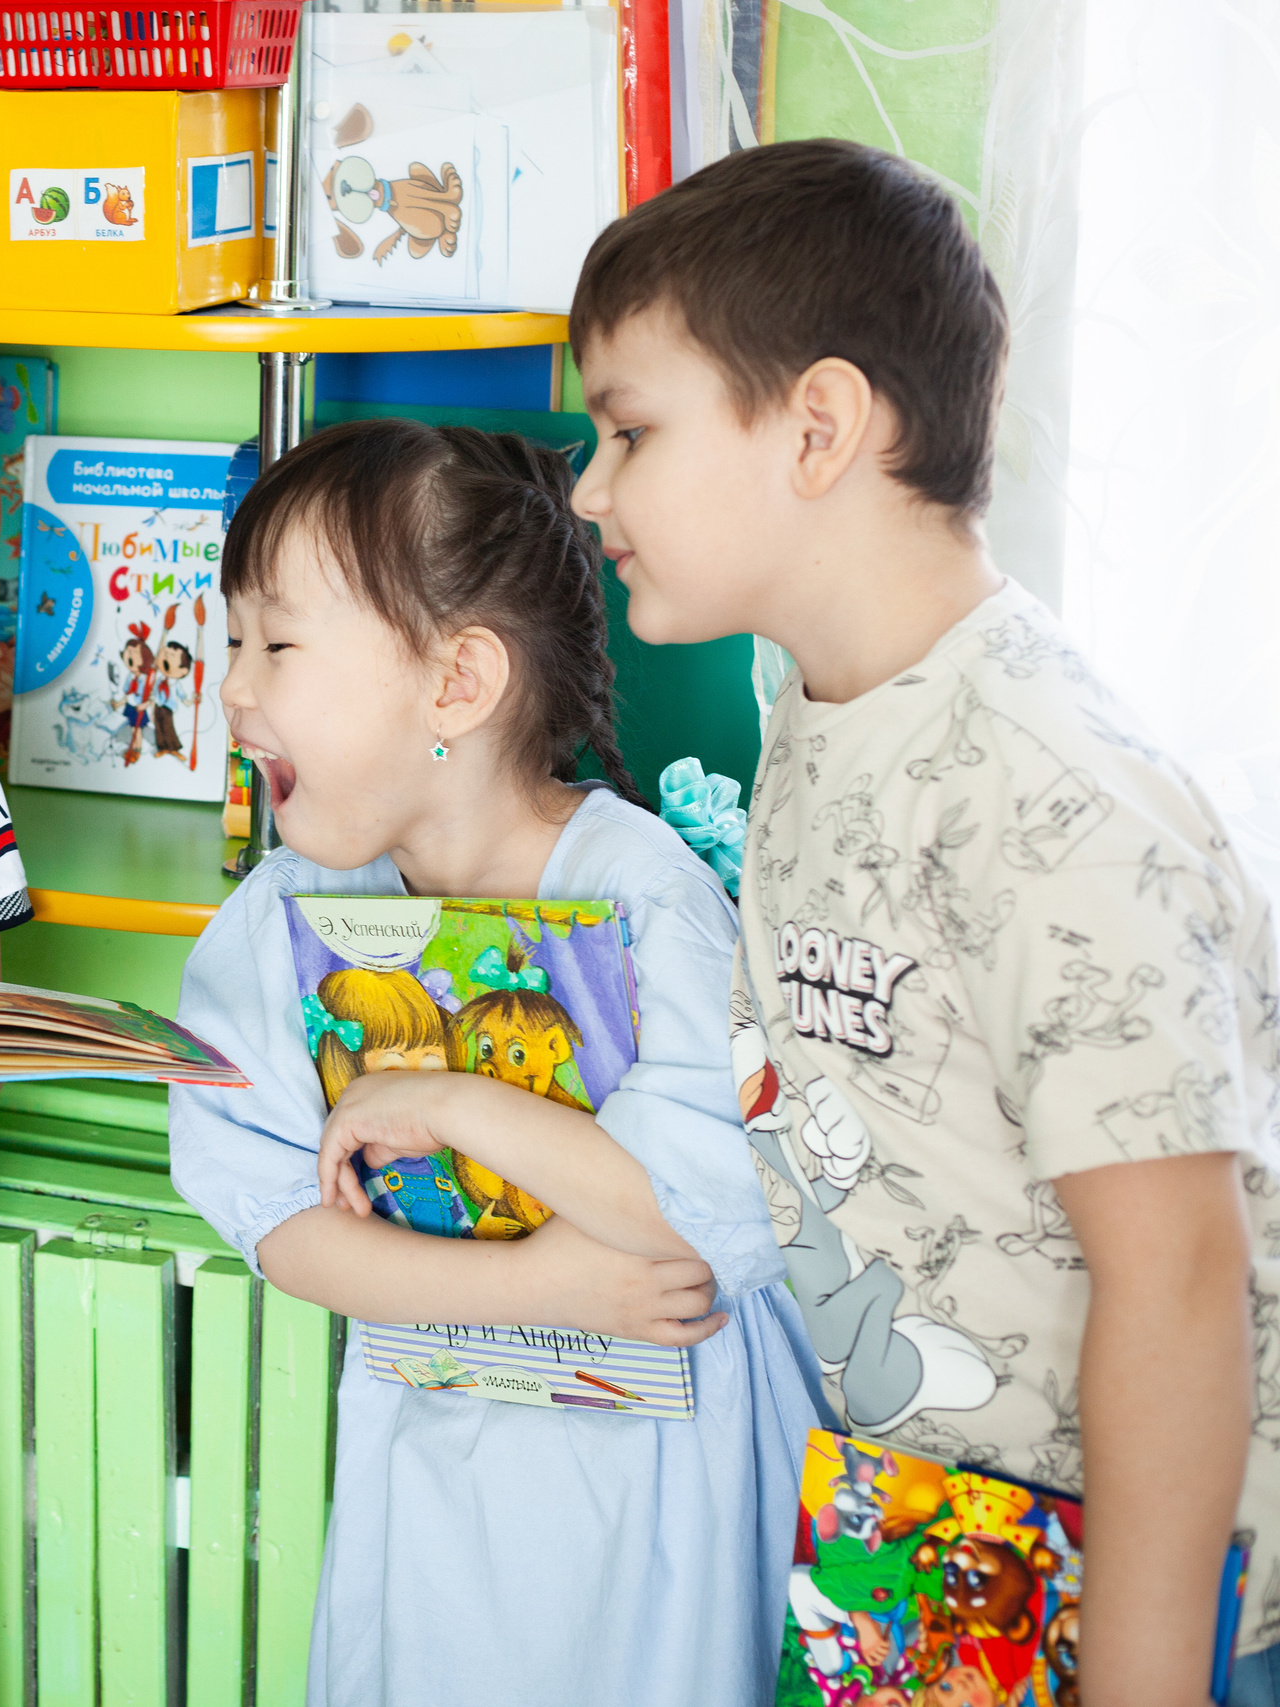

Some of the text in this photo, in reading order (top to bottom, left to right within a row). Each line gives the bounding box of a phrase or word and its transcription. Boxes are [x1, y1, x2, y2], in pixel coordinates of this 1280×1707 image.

[15, 177, 35, 204] А
[84, 177, 101, 204] Б
[28, 228, 57, 237] АРБУЗ
[95, 228, 124, 237] БЕЛКА
[73, 461, 173, 480] Библиотека
[72, 482, 163, 498] начальной
[69, 521, 220, 563] Любимые
[109, 566, 212, 602] Стихи
[46, 587, 84, 663] МИХАЛКОВ
[318, 916, 423, 941] Э. Успенский
[773, 921, 918, 1009] LOONEY
[483, 1324, 496, 1341] и
[508, 1324, 612, 1364] Анфису
